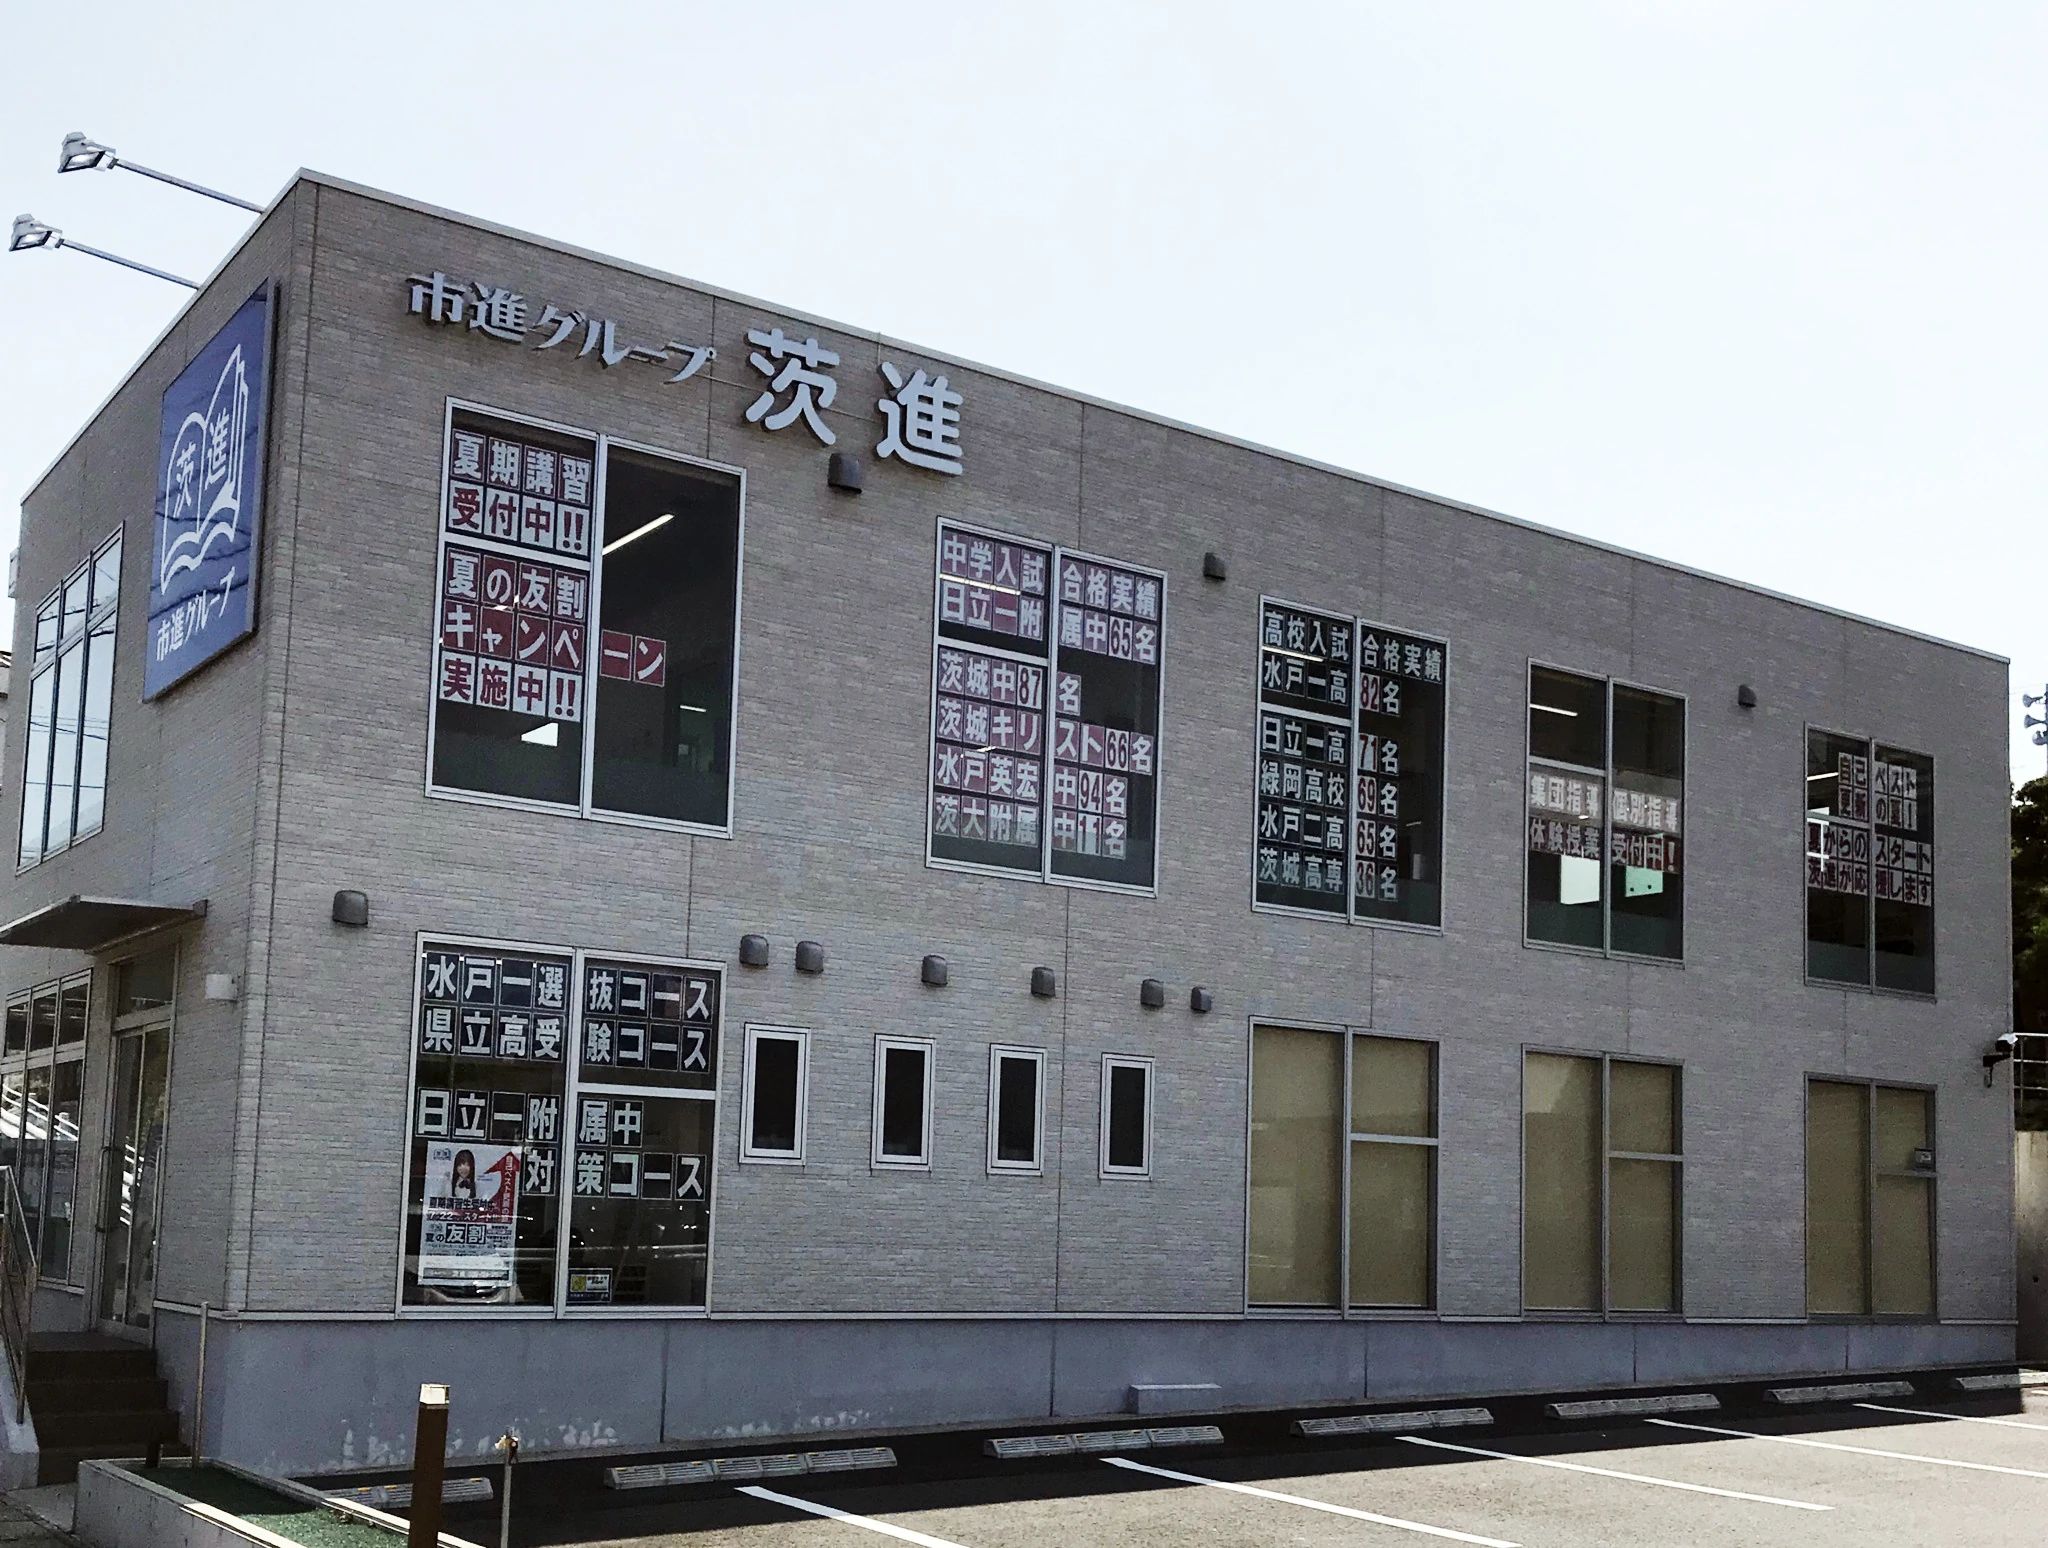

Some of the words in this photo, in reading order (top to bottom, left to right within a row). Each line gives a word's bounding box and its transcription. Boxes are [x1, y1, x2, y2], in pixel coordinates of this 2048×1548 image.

[408, 271, 717, 384] 市進グループ
[744, 327, 964, 476] 茨進
[173, 407, 230, 518] 茨進
[453, 431, 592, 505] 夏期講習
[451, 487, 584, 553] 受付中!!
[155, 565, 237, 662] 市進グループ
[447, 551, 586, 620] 夏の友割
[444, 604, 664, 680] キャンペーン
[441, 659, 577, 718] 実施中!!
